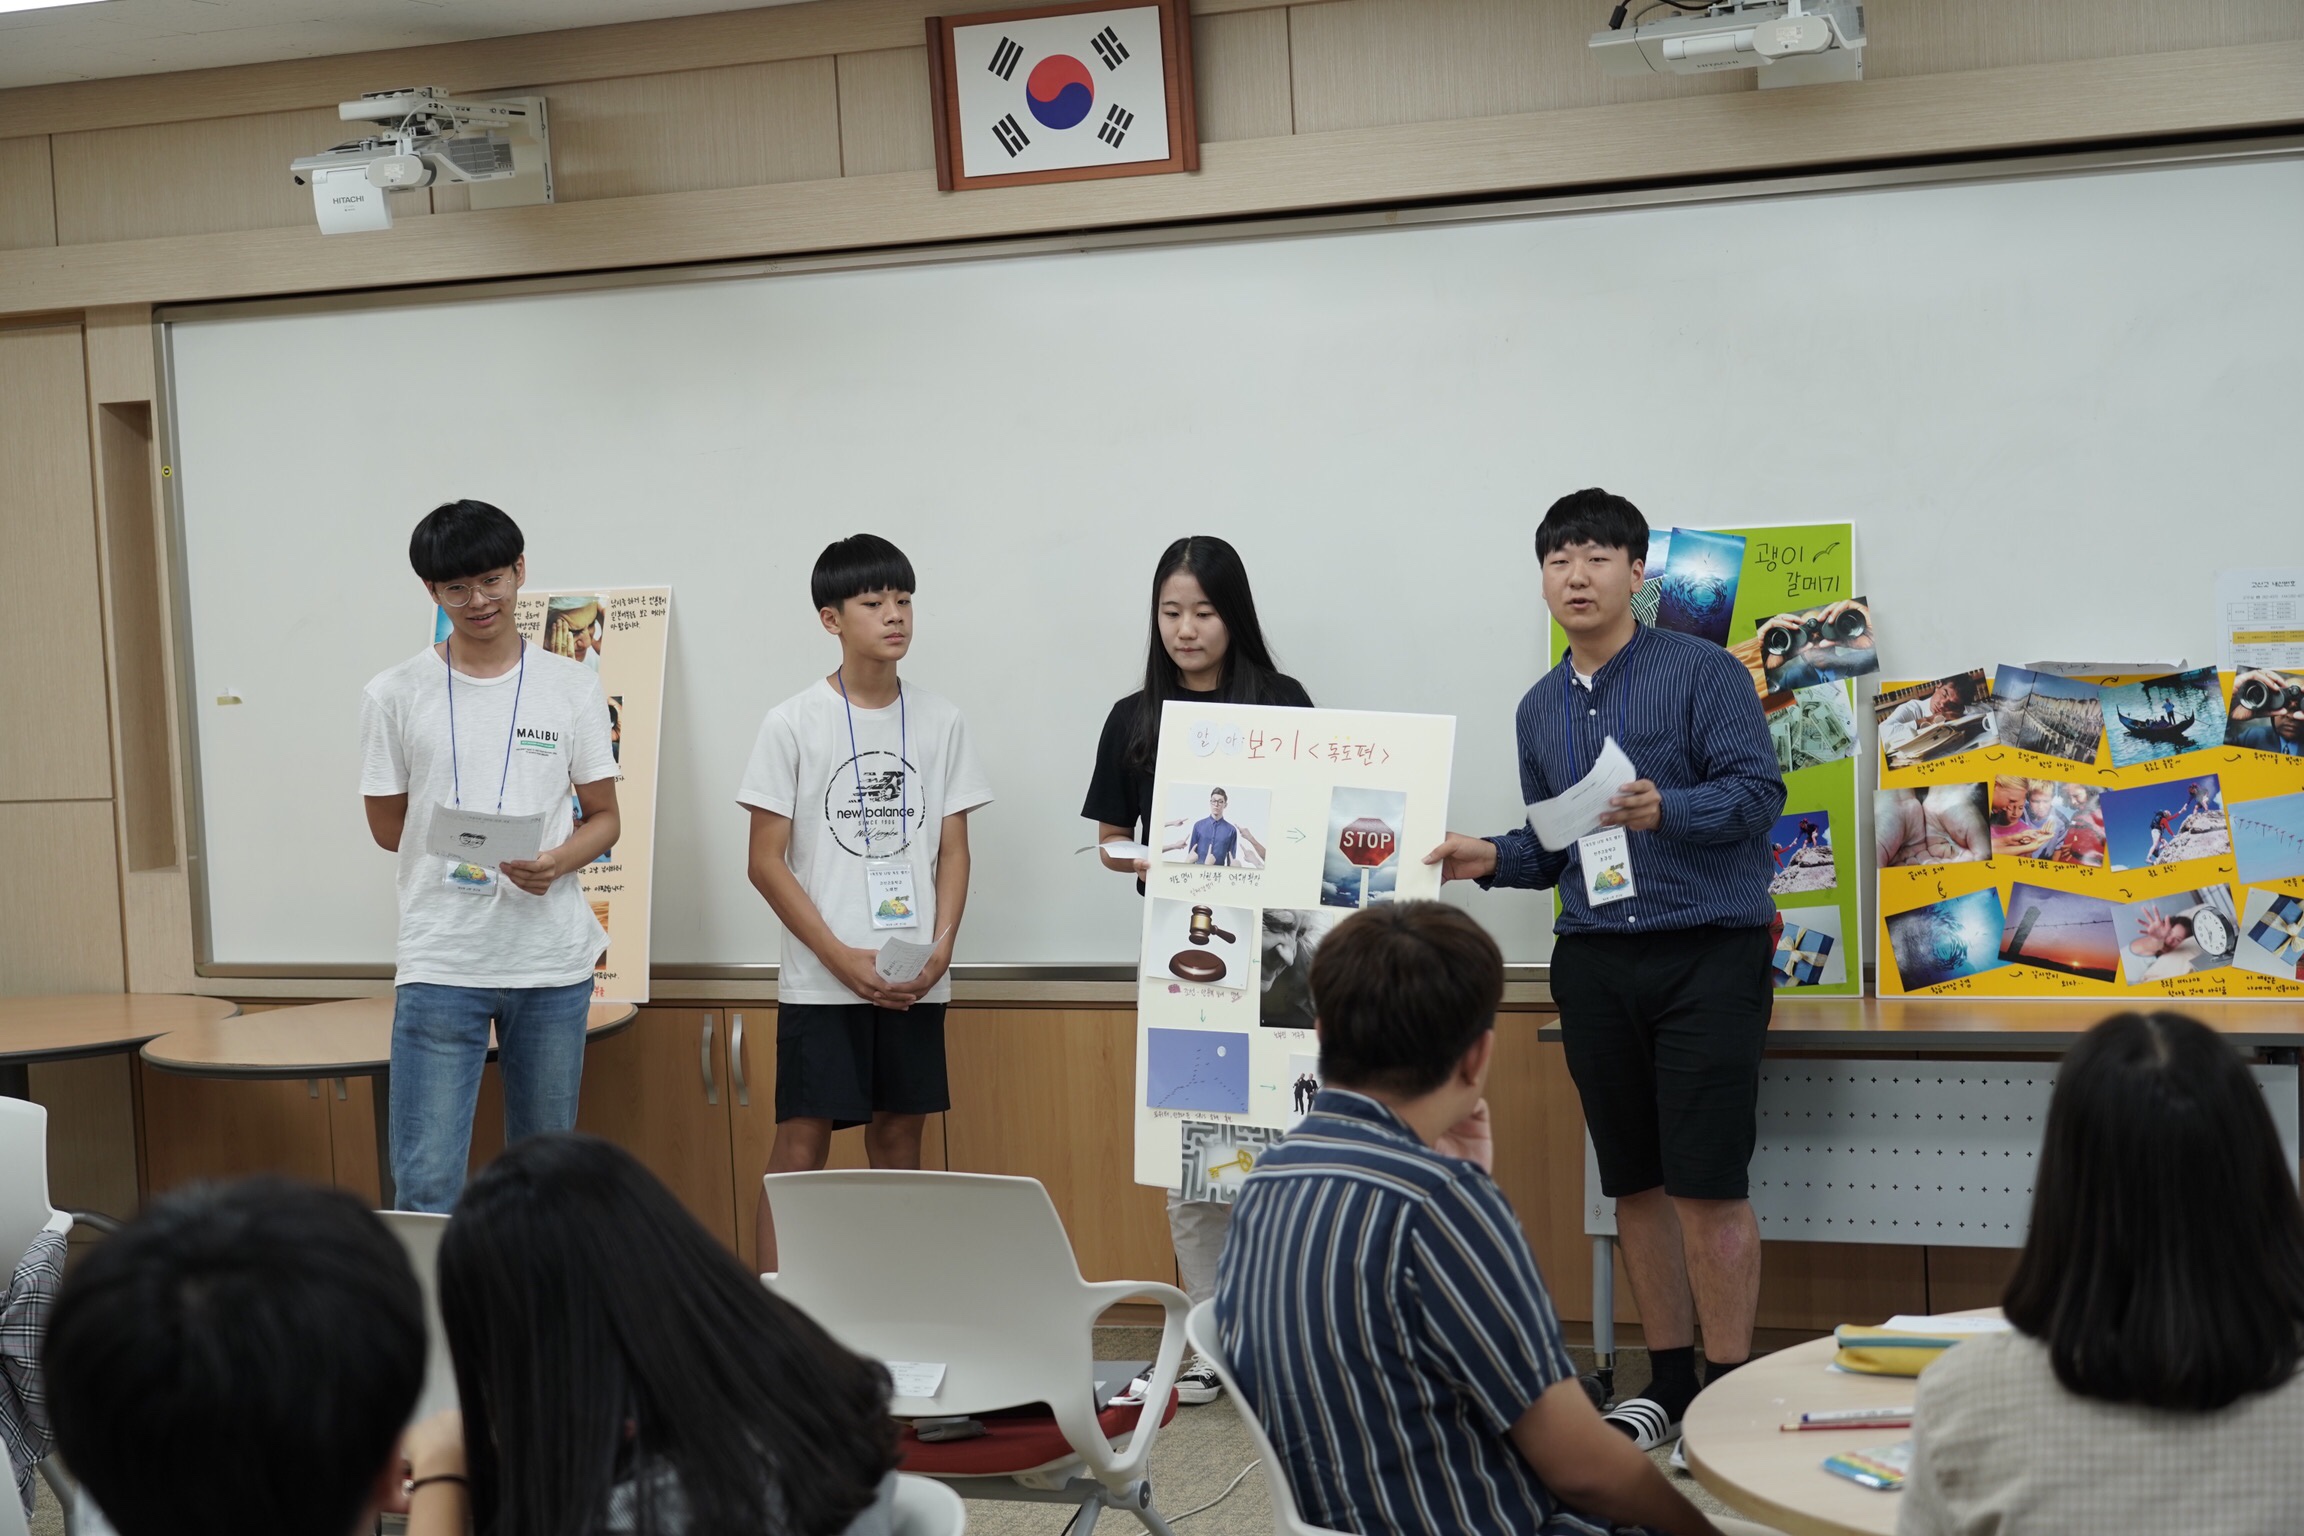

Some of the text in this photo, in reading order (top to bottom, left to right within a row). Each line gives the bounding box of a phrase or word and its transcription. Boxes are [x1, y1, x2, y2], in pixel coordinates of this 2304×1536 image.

[332, 195, 365, 205] HITACHI
[1755, 543, 1803, 572] 괭이
[1786, 571, 1840, 597] 갈메기
[517, 728, 559, 742] MALIBU
[2017, 752, 2038, 763] 오징어
[1917, 761, 1946, 775] 학업에
[837, 806, 915, 819] new balance
[1343, 830, 1392, 850] STOP
[2147, 869, 2158, 878] 독도
